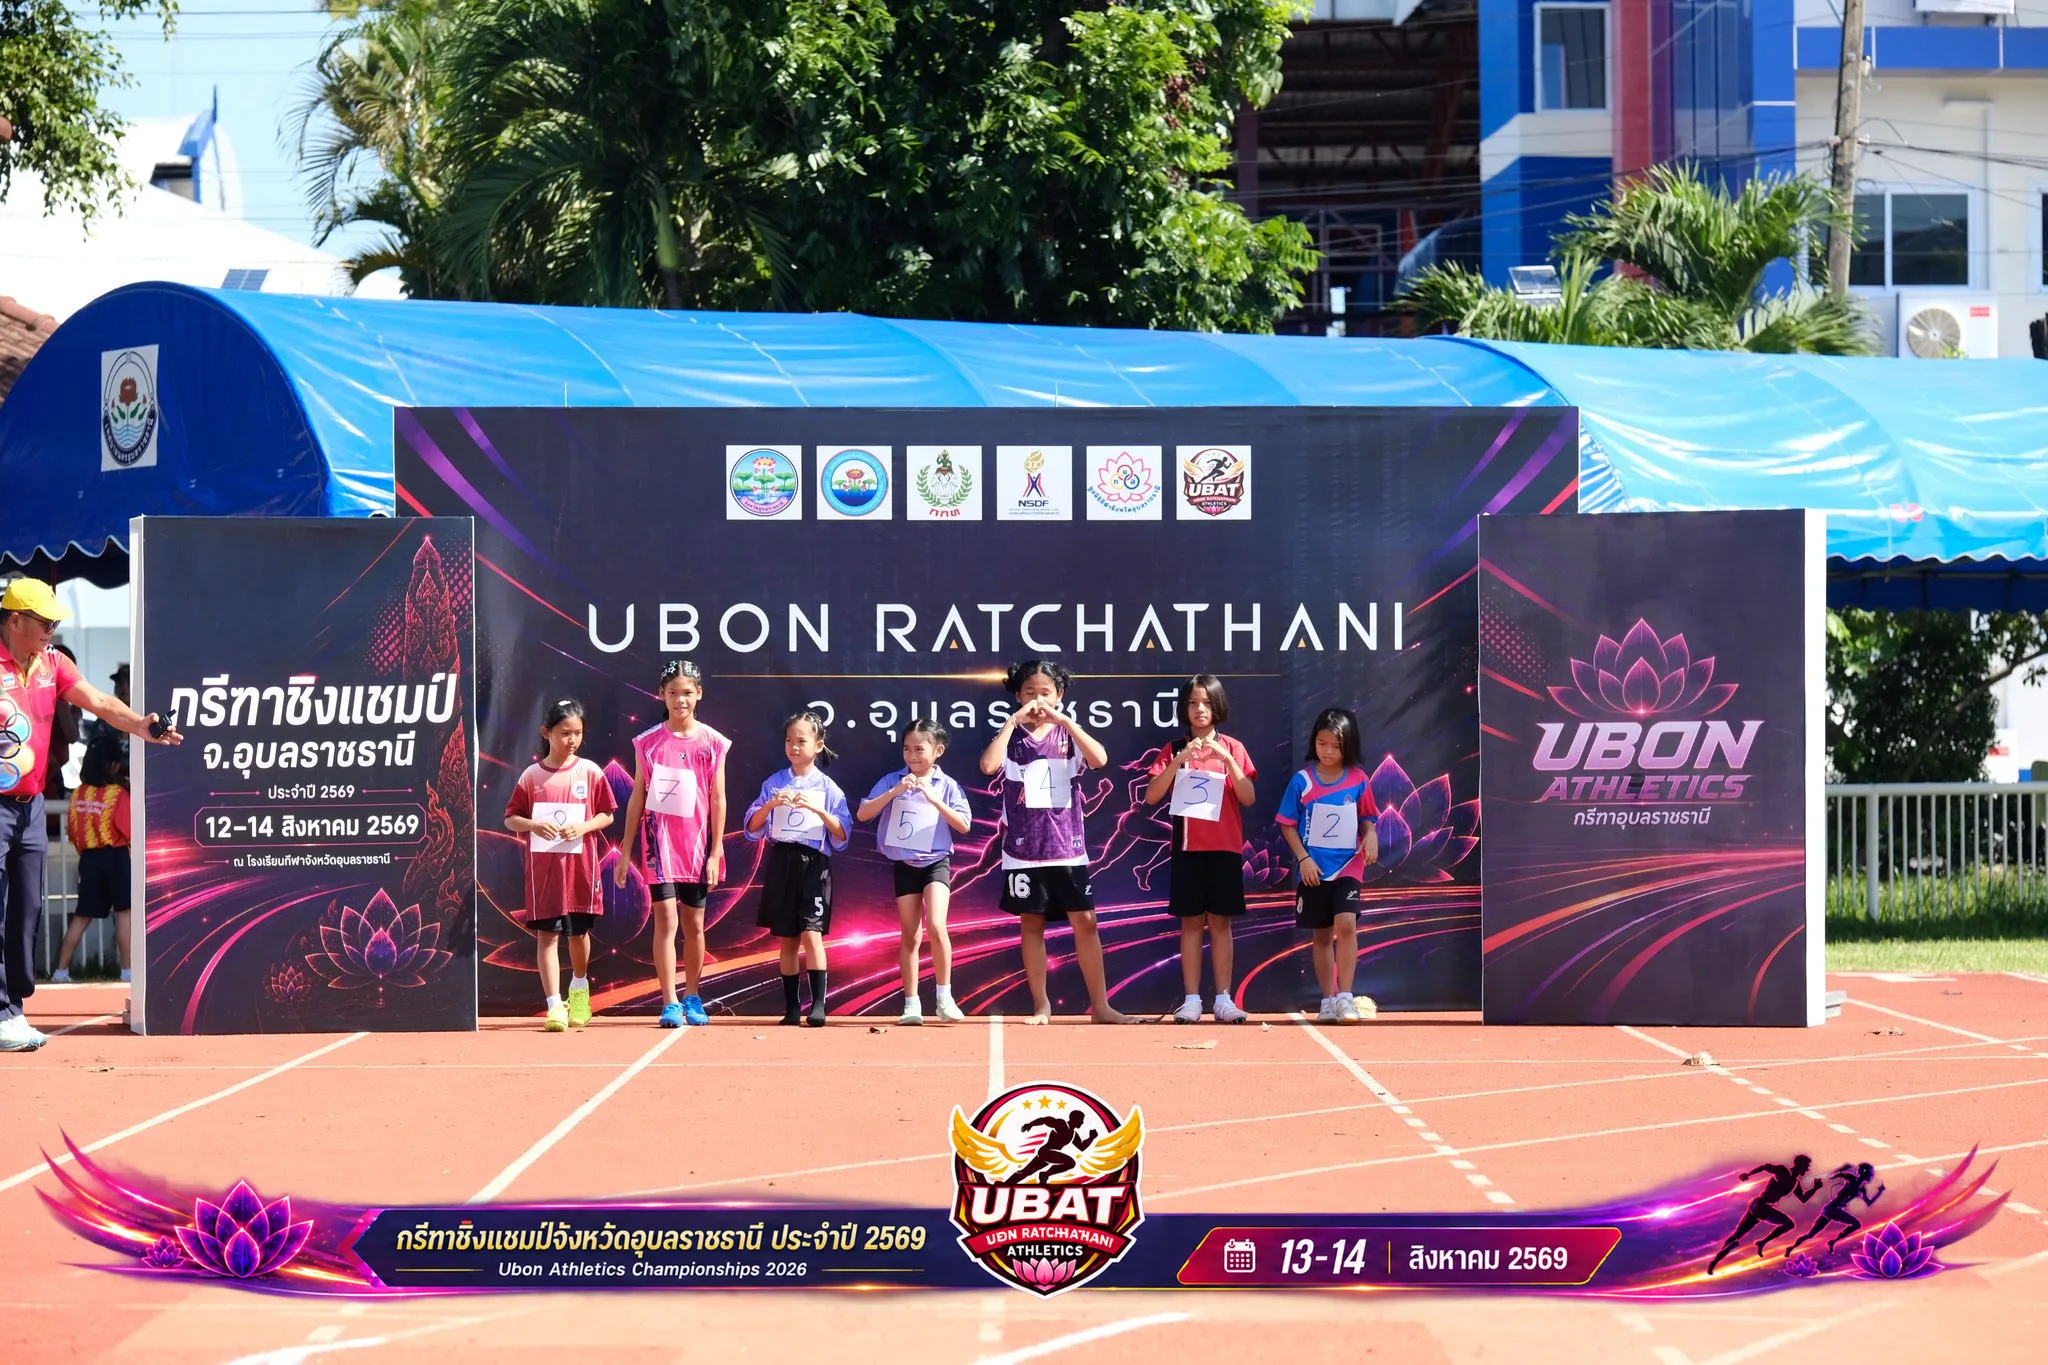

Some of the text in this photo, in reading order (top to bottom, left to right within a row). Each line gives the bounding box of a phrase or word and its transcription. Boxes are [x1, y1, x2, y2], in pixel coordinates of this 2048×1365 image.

[1188, 483, 1240, 497] UBAT
[588, 602, 1403, 653] UBON RATCHATHANI
[170, 673, 458, 728] กรีฑาชิงแชมป์
[203, 730, 416, 780] จ.อุบลราชธานี
[1532, 720, 1765, 771] UBON
[268, 785, 355, 799] ประจำปี 2569
[659, 778, 680, 803] 7
[1039, 766, 1056, 798] 4
[1183, 776, 1210, 805] 3
[1535, 774, 1752, 802] ATHLETICS
[206, 815, 419, 838] 12-14 สิงหาคม 2569
[897, 811, 917, 841] 5
[1322, 813, 1341, 838] 2
[1573, 806, 1712, 830] กรีฑาอุบลราชธานี
[233, 853, 391, 868] ณ โรงเรียนกีฬาจังหวัดอุบลราชธานี
[1008, 872, 1031, 899] 16
[814, 896, 824, 917] 5
